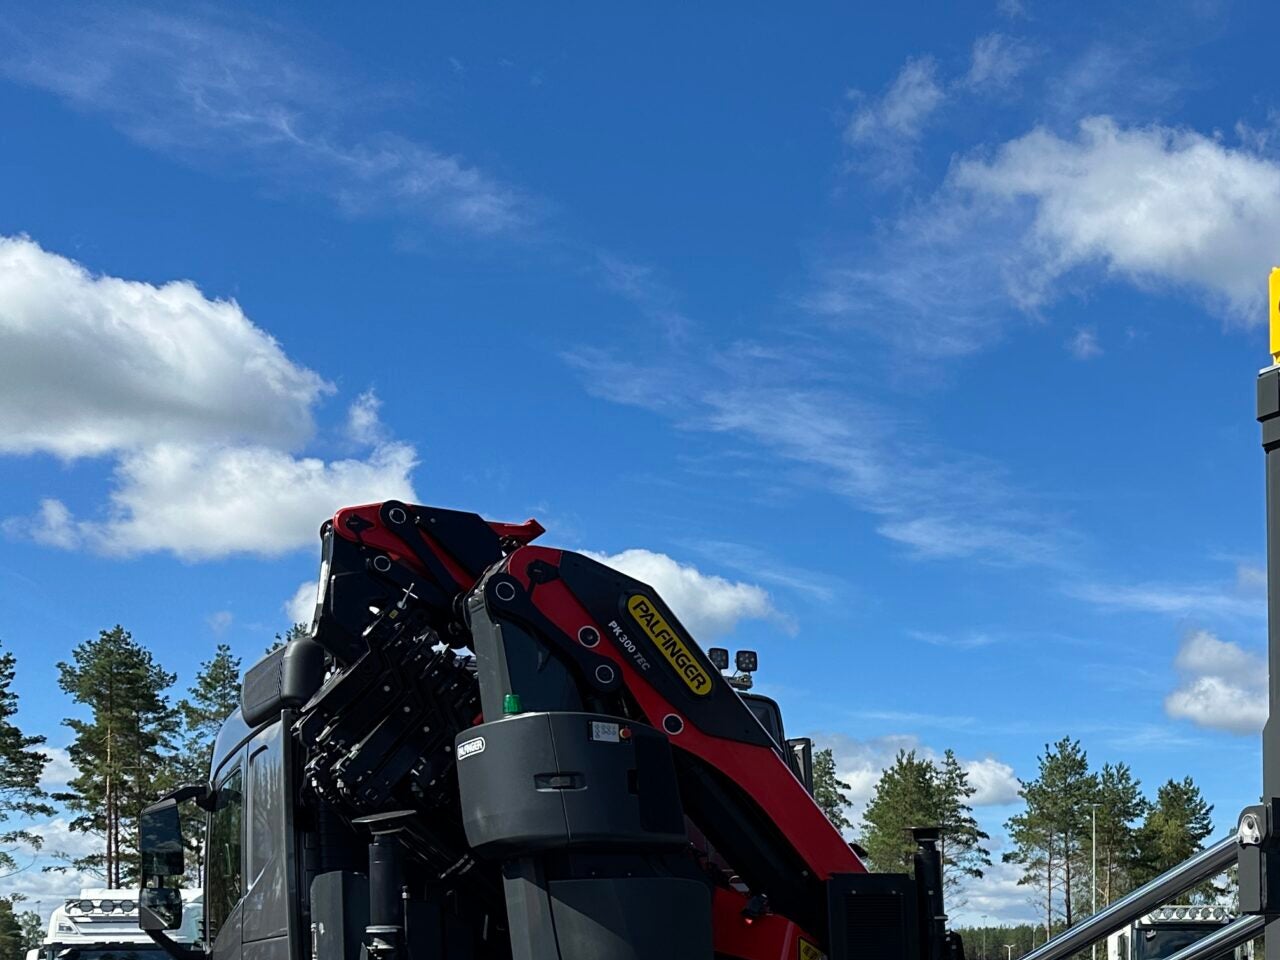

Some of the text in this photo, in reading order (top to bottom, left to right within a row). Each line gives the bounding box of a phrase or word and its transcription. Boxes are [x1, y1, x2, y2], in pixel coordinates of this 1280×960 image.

[607, 620, 651, 671] PK 300 TEC
[632, 600, 707, 690] PALFINGER
